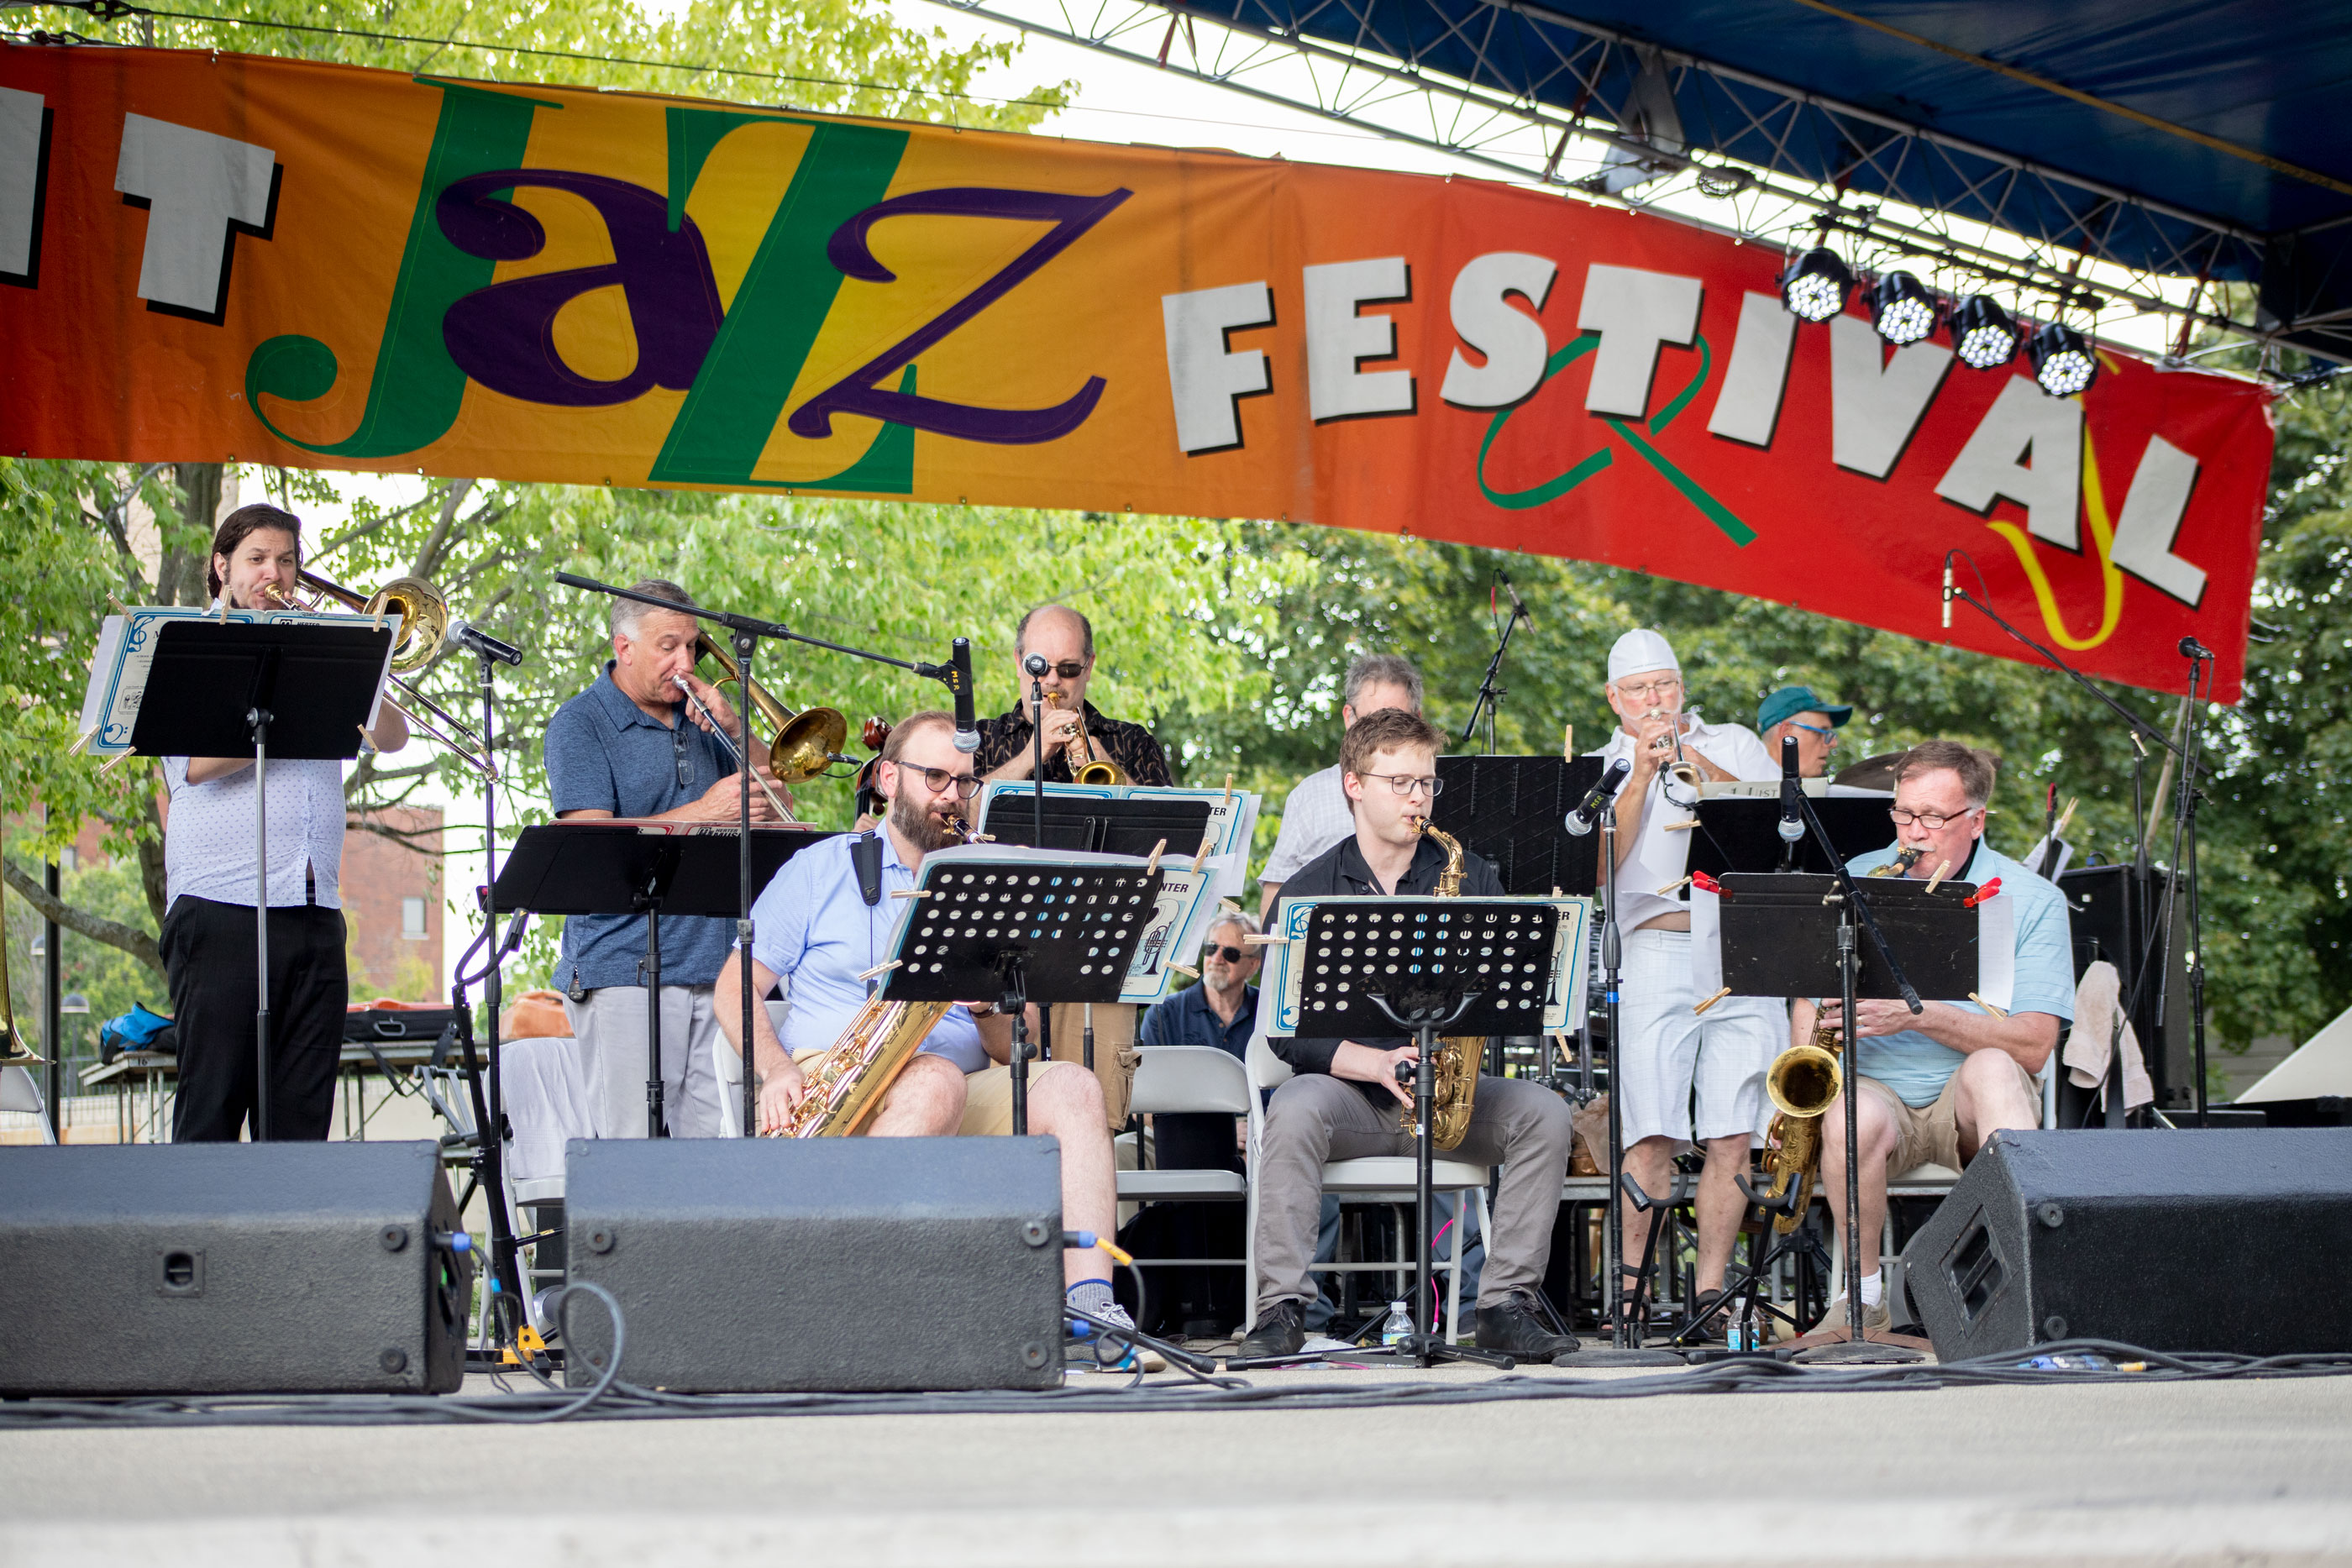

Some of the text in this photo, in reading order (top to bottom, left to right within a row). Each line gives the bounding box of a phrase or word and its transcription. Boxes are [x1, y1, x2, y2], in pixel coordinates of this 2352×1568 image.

[1161, 251, 2208, 608] FESTIVAL
[951, 670, 960, 691] MSR
[1589, 794, 1604, 809] MSR
[138, 1057, 149, 1067] 16
